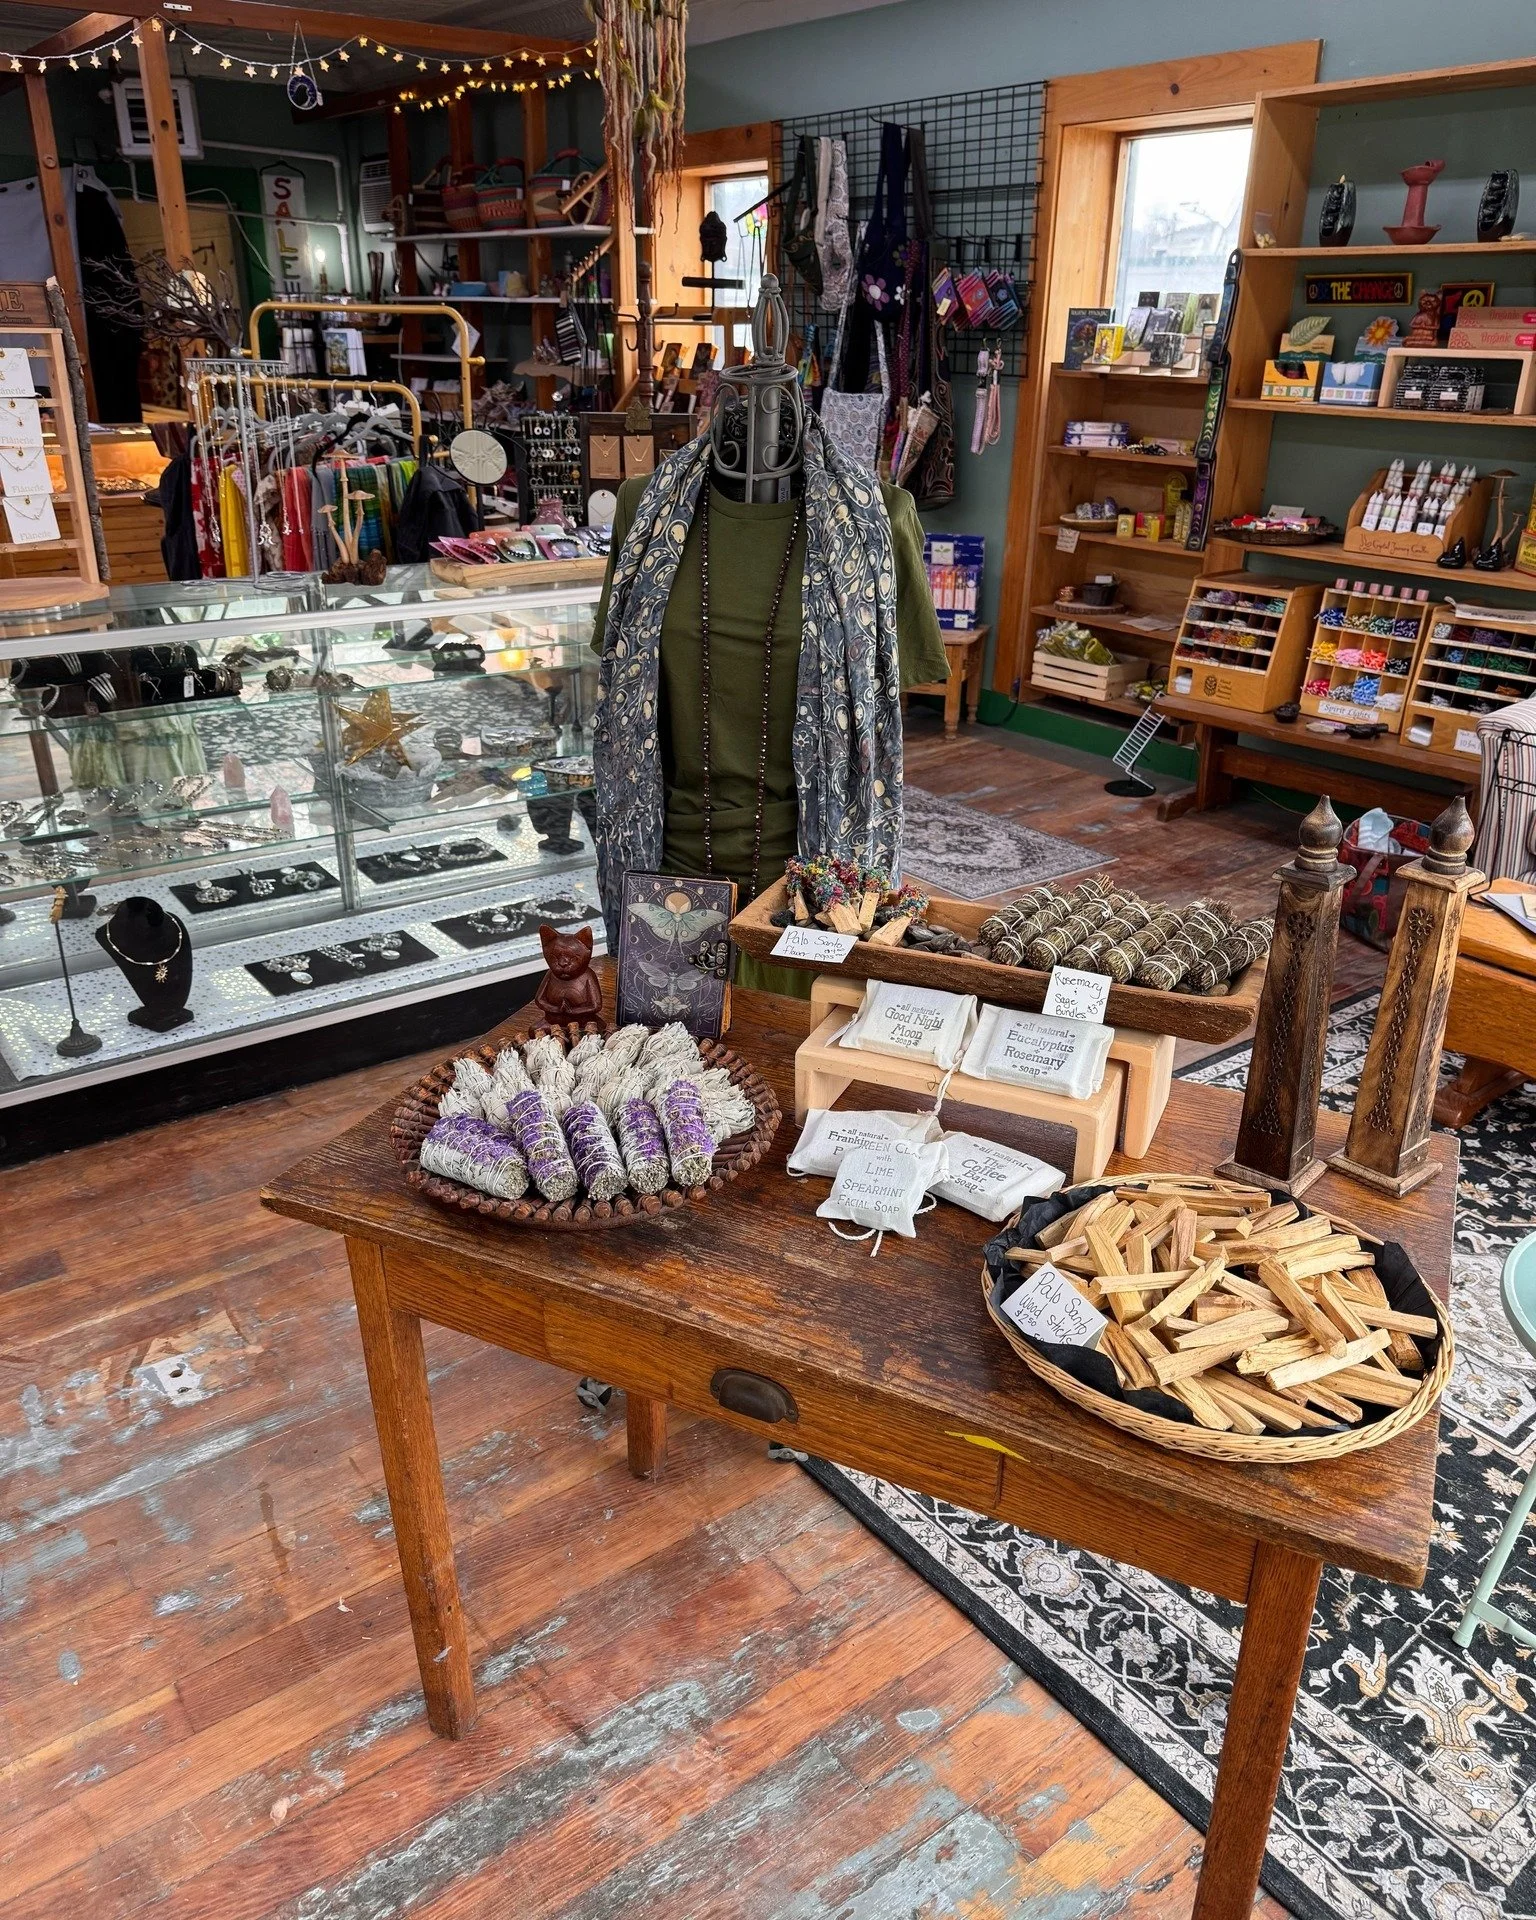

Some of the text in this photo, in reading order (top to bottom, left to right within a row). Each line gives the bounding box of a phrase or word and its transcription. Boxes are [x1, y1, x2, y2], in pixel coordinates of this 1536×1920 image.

[1330, 281, 1352, 300] THE
[1324, 704, 1346, 714] Spirit
[785, 930, 843, 948] Palo Santo
[1054, 972, 1103, 1000] Rosemary
[901, 1003, 937, 1016] all natural
[1054, 993, 1079, 1009] Sage
[884, 1006, 945, 1031] Good Night
[1055, 1004, 1087, 1019] Bundles
[890, 1023, 923, 1041] Moon
[1022, 1021, 1069, 1038] all natural
[895, 1037, 912, 1048] soap
[1006, 1029, 1075, 1055] Eucalyptus
[1003, 1045, 1065, 1071] Rosemary
[1018, 1064, 1041, 1078] soap
[847, 1128, 884, 1141] all natural
[876, 1154, 892, 1163] with
[979, 1145, 1028, 1169] all natural
[983, 1156, 1007, 1170] The
[864, 1162, 895, 1178] LIME
[961, 1158, 1007, 1182] Coffee
[962, 1169, 987, 1183] Bar
[841, 1178, 906, 1198] SPEARMINT
[954, 1176, 978, 1194] soap
[837, 1194, 900, 1215] FACIAL SOAP
[1018, 1293, 1049, 1319] Wood
[1032, 1271, 1094, 1336] Palo Santo
